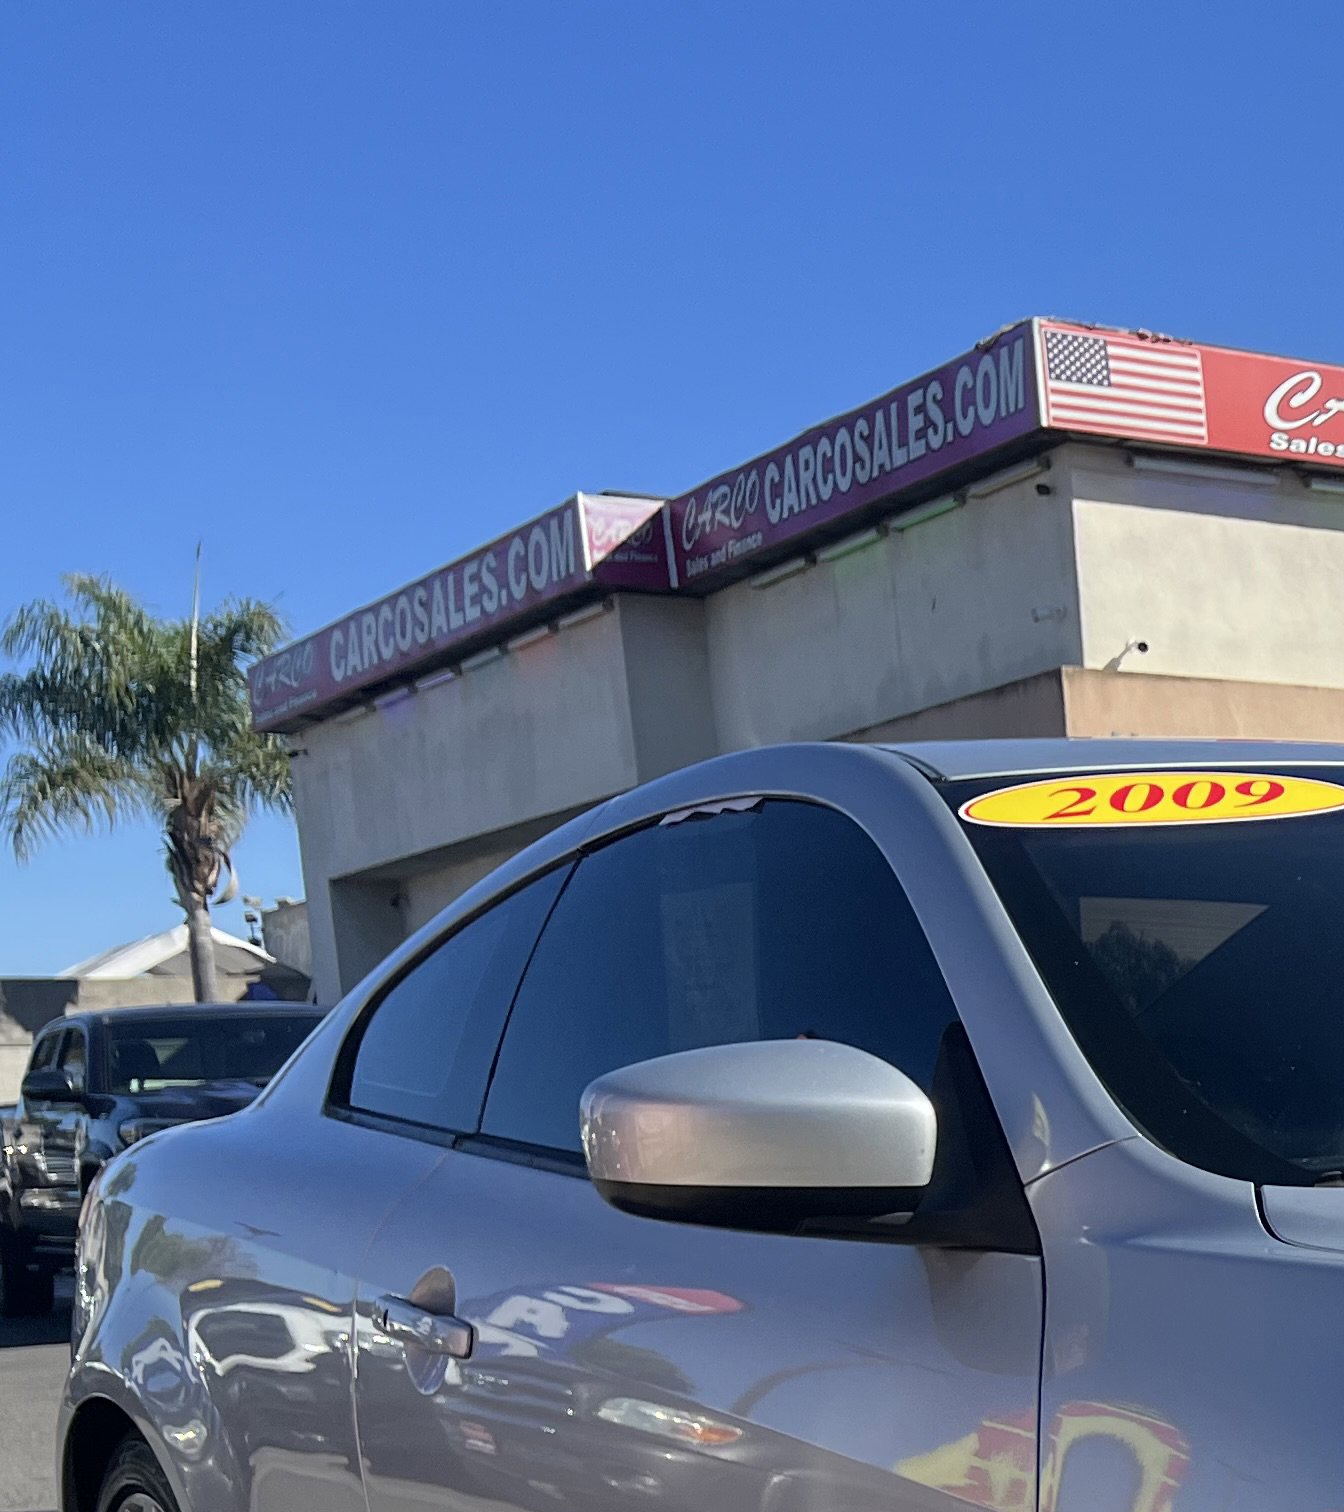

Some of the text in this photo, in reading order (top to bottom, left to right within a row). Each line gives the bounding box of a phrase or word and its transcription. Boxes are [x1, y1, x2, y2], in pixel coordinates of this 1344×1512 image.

[682, 337, 1025, 550] CARCO CARCOSALES.COM
[329, 508, 576, 683] CARCOSALES.COM
[1043, 779, 1287, 821] 2009
